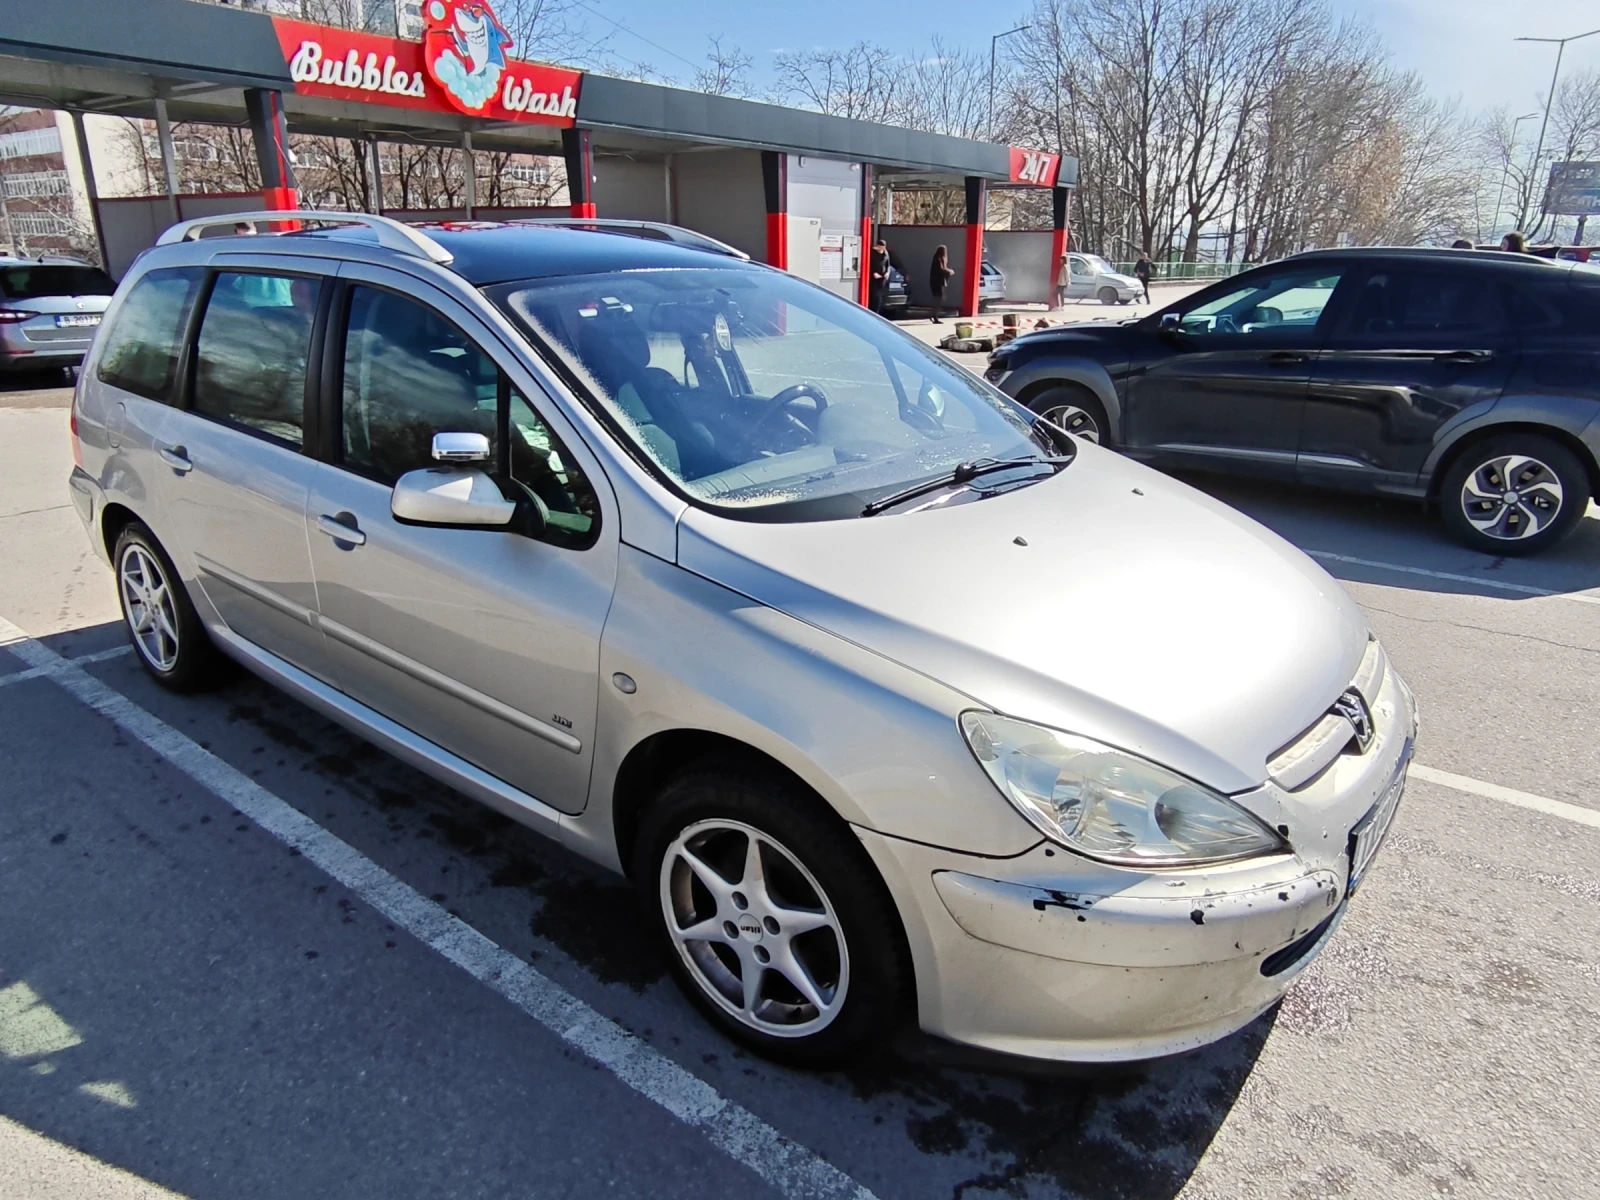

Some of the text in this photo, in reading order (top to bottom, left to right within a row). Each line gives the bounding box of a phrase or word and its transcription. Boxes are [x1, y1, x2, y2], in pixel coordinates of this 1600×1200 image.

[290, 40, 577, 119] Bubbles Wash
[1018, 152, 1051, 184] 24/7
